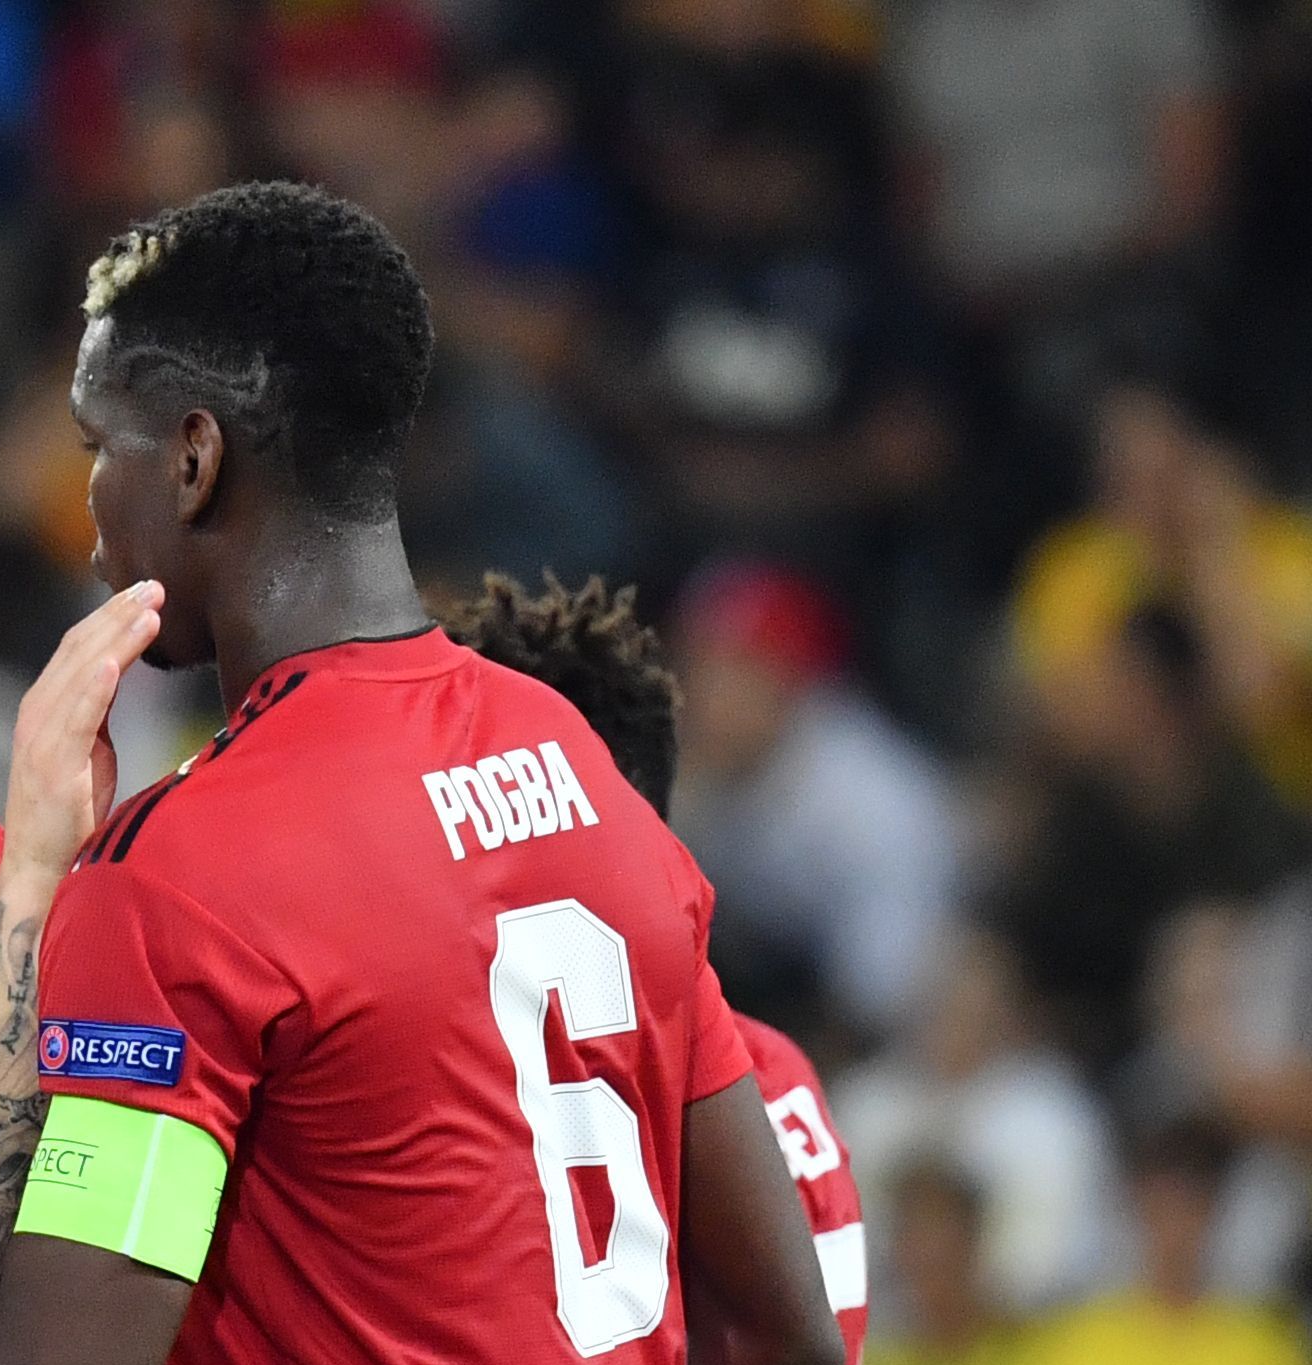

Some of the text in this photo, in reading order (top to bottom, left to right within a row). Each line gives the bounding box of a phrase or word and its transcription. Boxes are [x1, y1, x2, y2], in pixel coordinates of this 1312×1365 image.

[421, 740, 600, 861] POGBA
[71, 1037, 180, 1070] RESPECT
[30, 1147, 94, 1177] PECT
[489, 898, 669, 1358] 6
